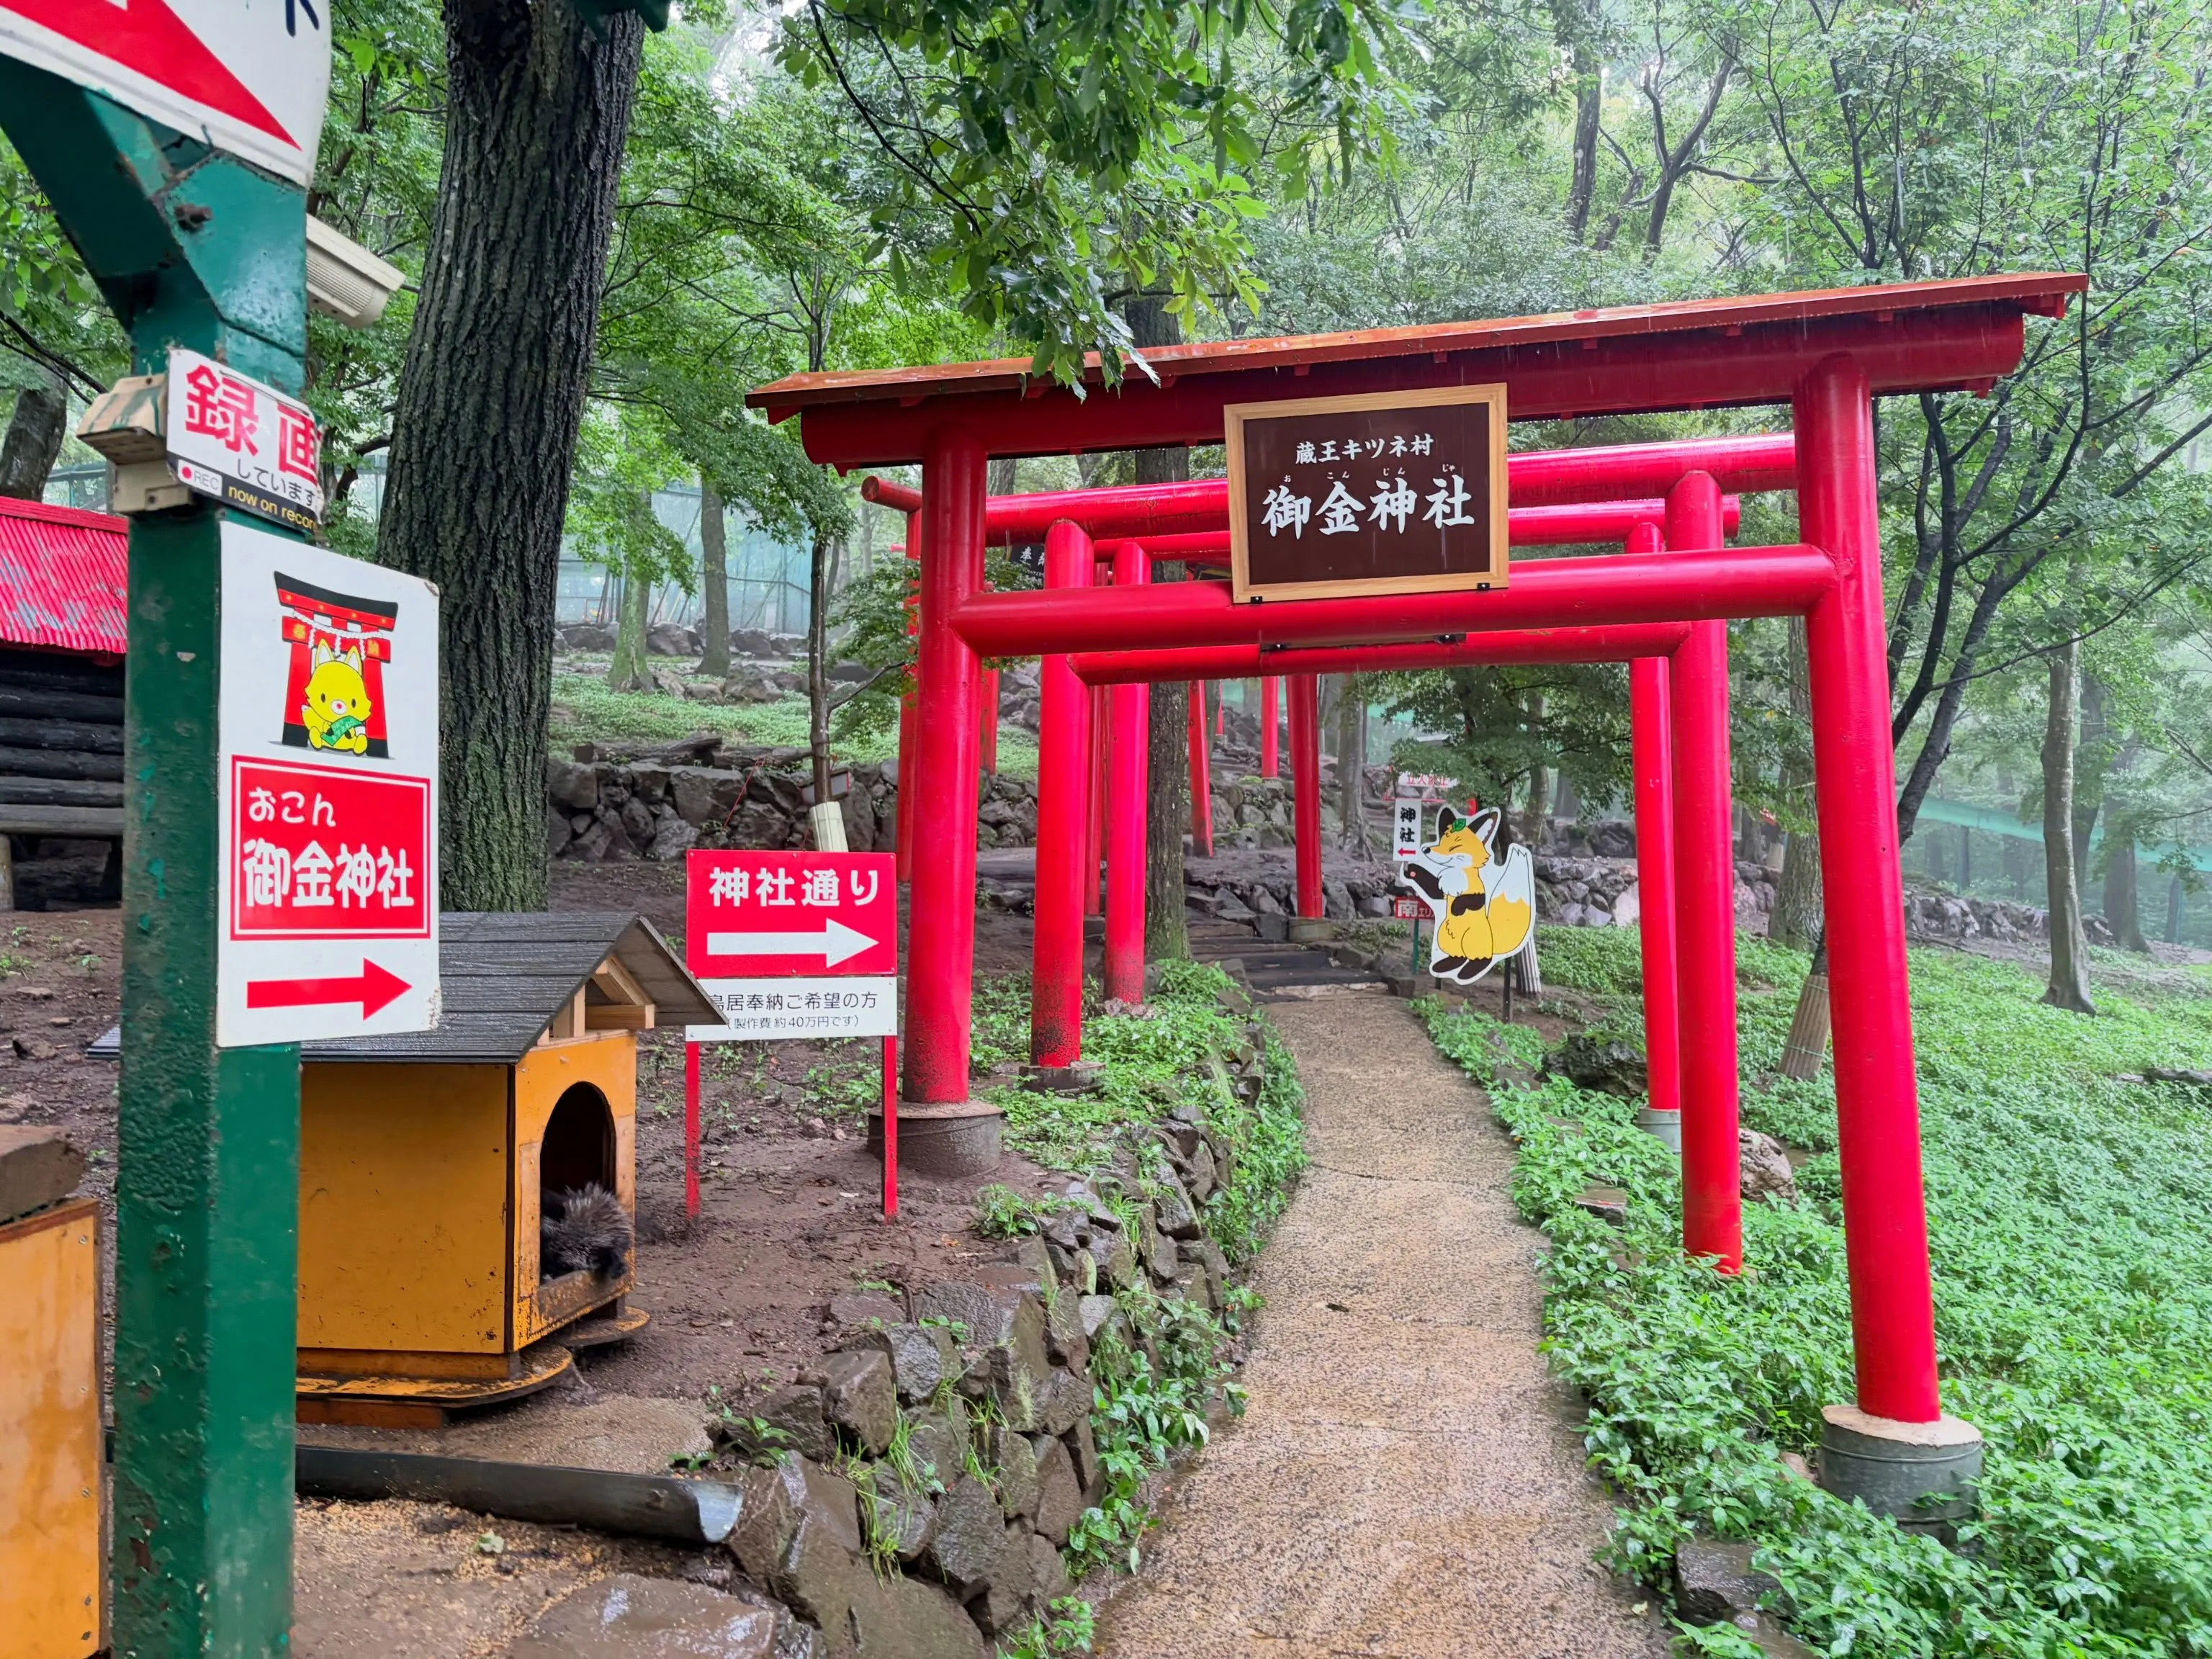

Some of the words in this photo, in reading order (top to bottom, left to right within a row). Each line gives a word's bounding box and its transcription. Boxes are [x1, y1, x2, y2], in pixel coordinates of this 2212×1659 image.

[185, 364, 322, 487] 録画
[1295, 433, 1434, 464] 蔵王キツネ村
[193, 471, 220, 490] REC
[228, 486, 258, 508] now
[260, 499, 278, 516] on
[237, 459, 315, 507] しています
[1261, 474, 1475, 540] 御金神社
[248, 786, 336, 827] おこん
[1400, 807, 1416, 842] 神社
[243, 837, 415, 909] 御金神社
[709, 866, 878, 907] 神社通り
